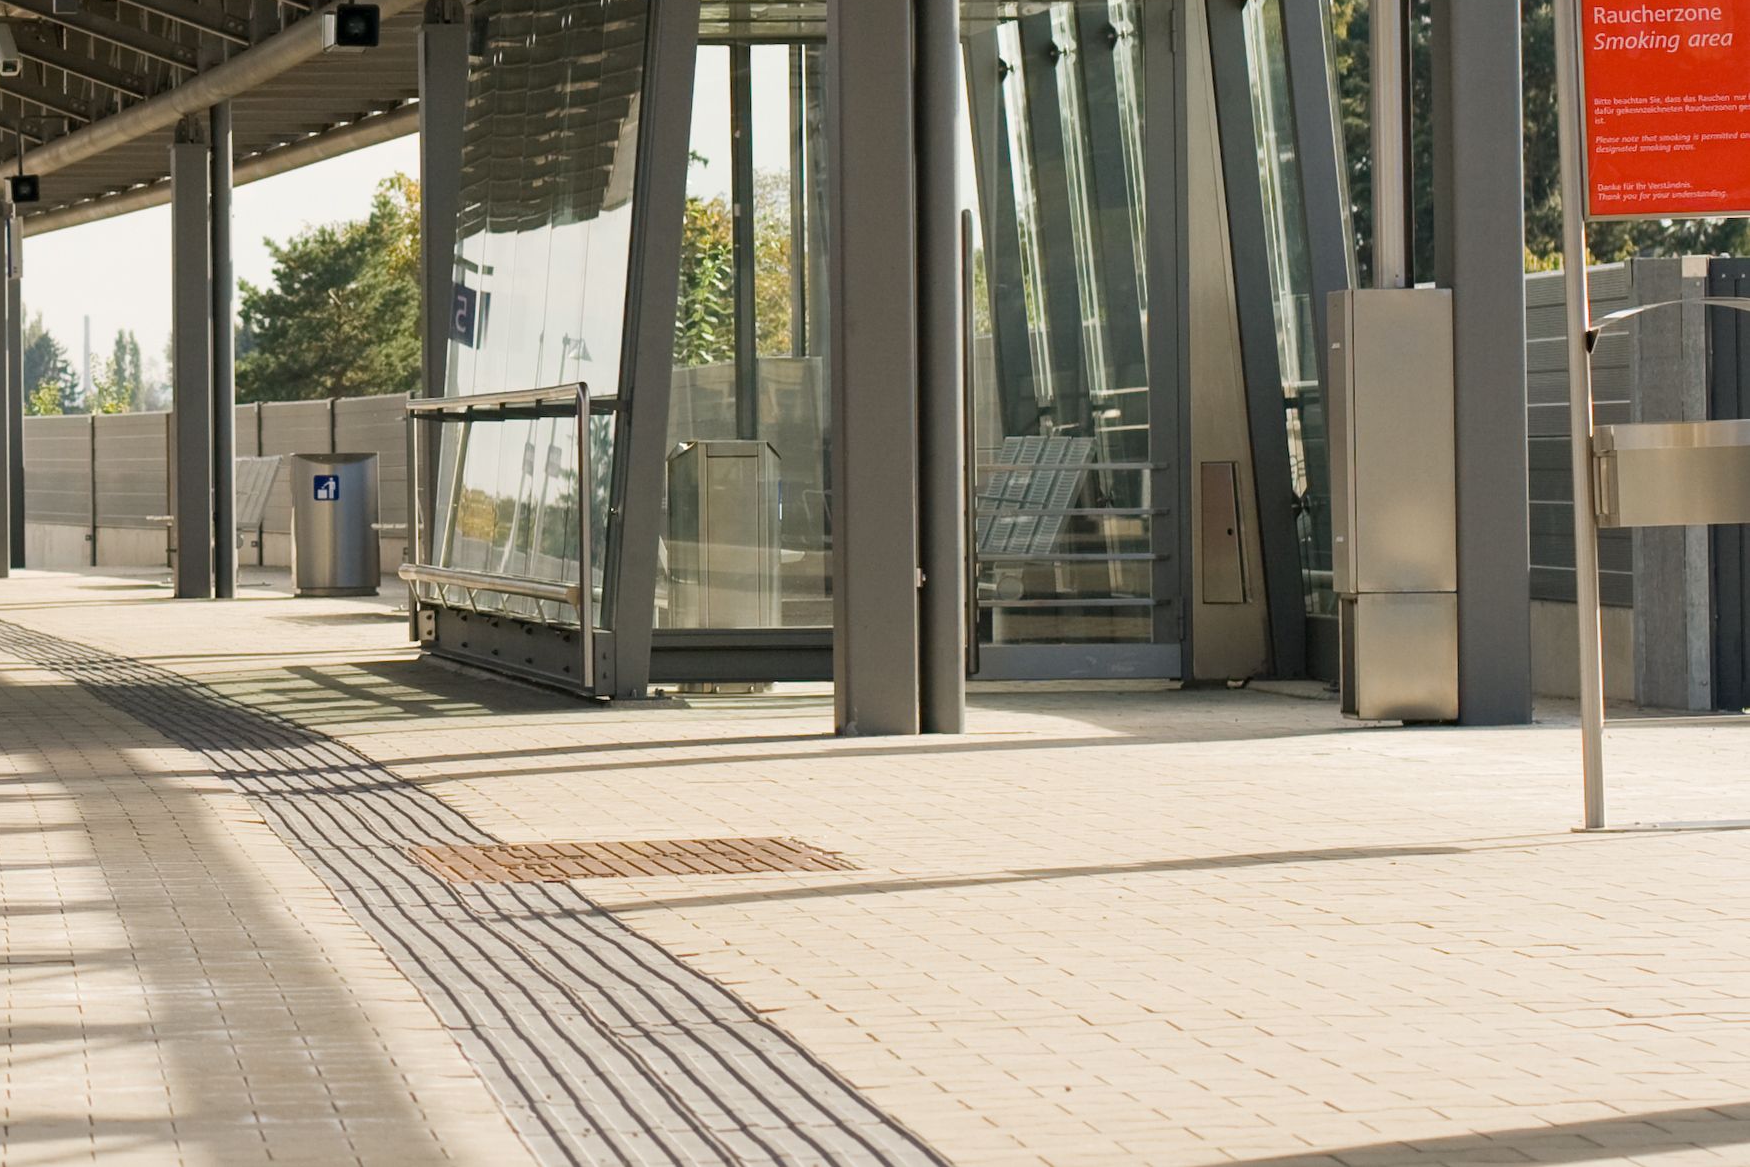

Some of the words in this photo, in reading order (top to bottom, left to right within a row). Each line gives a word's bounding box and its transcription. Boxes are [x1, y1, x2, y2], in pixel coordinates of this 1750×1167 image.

[1593, 4, 1722, 24] Raucherzone
[1593, 31, 1680, 53] Smoking
[1688, 33, 1733, 47] area
[1613, 96, 1648, 105] beachten
[1683, 95, 1696, 103] das
[1698, 94, 1730, 102] Rauchen
[1594, 106, 1614, 115] dafür
[1616, 105, 1683, 116] gekennzeichneten
[1685, 104, 1737, 113] Raucherzonen
[1594, 117, 1606, 125] ist.
[1595, 136, 1619, 144] Please
[1622, 135, 1639, 143] note
[1659, 133, 1691, 143] smoking
[1693, 133, 1699, 141] is
[1701, 131, 1738, 142] permitted
[1595, 145, 1637, 154] designated
[1640, 144, 1671, 153] smoking
[1597, 183, 1621, 191] Danke
[1623, 182, 1634, 190] für
[1636, 182, 1646, 190] Ihr
[1648, 180, 1693, 189] Verständnis.
[1598, 192, 1621, 201] Thank
[1622, 193, 1637, 202] you
[1639, 192, 1651, 202] for
[1652, 192, 1670, 201] your
